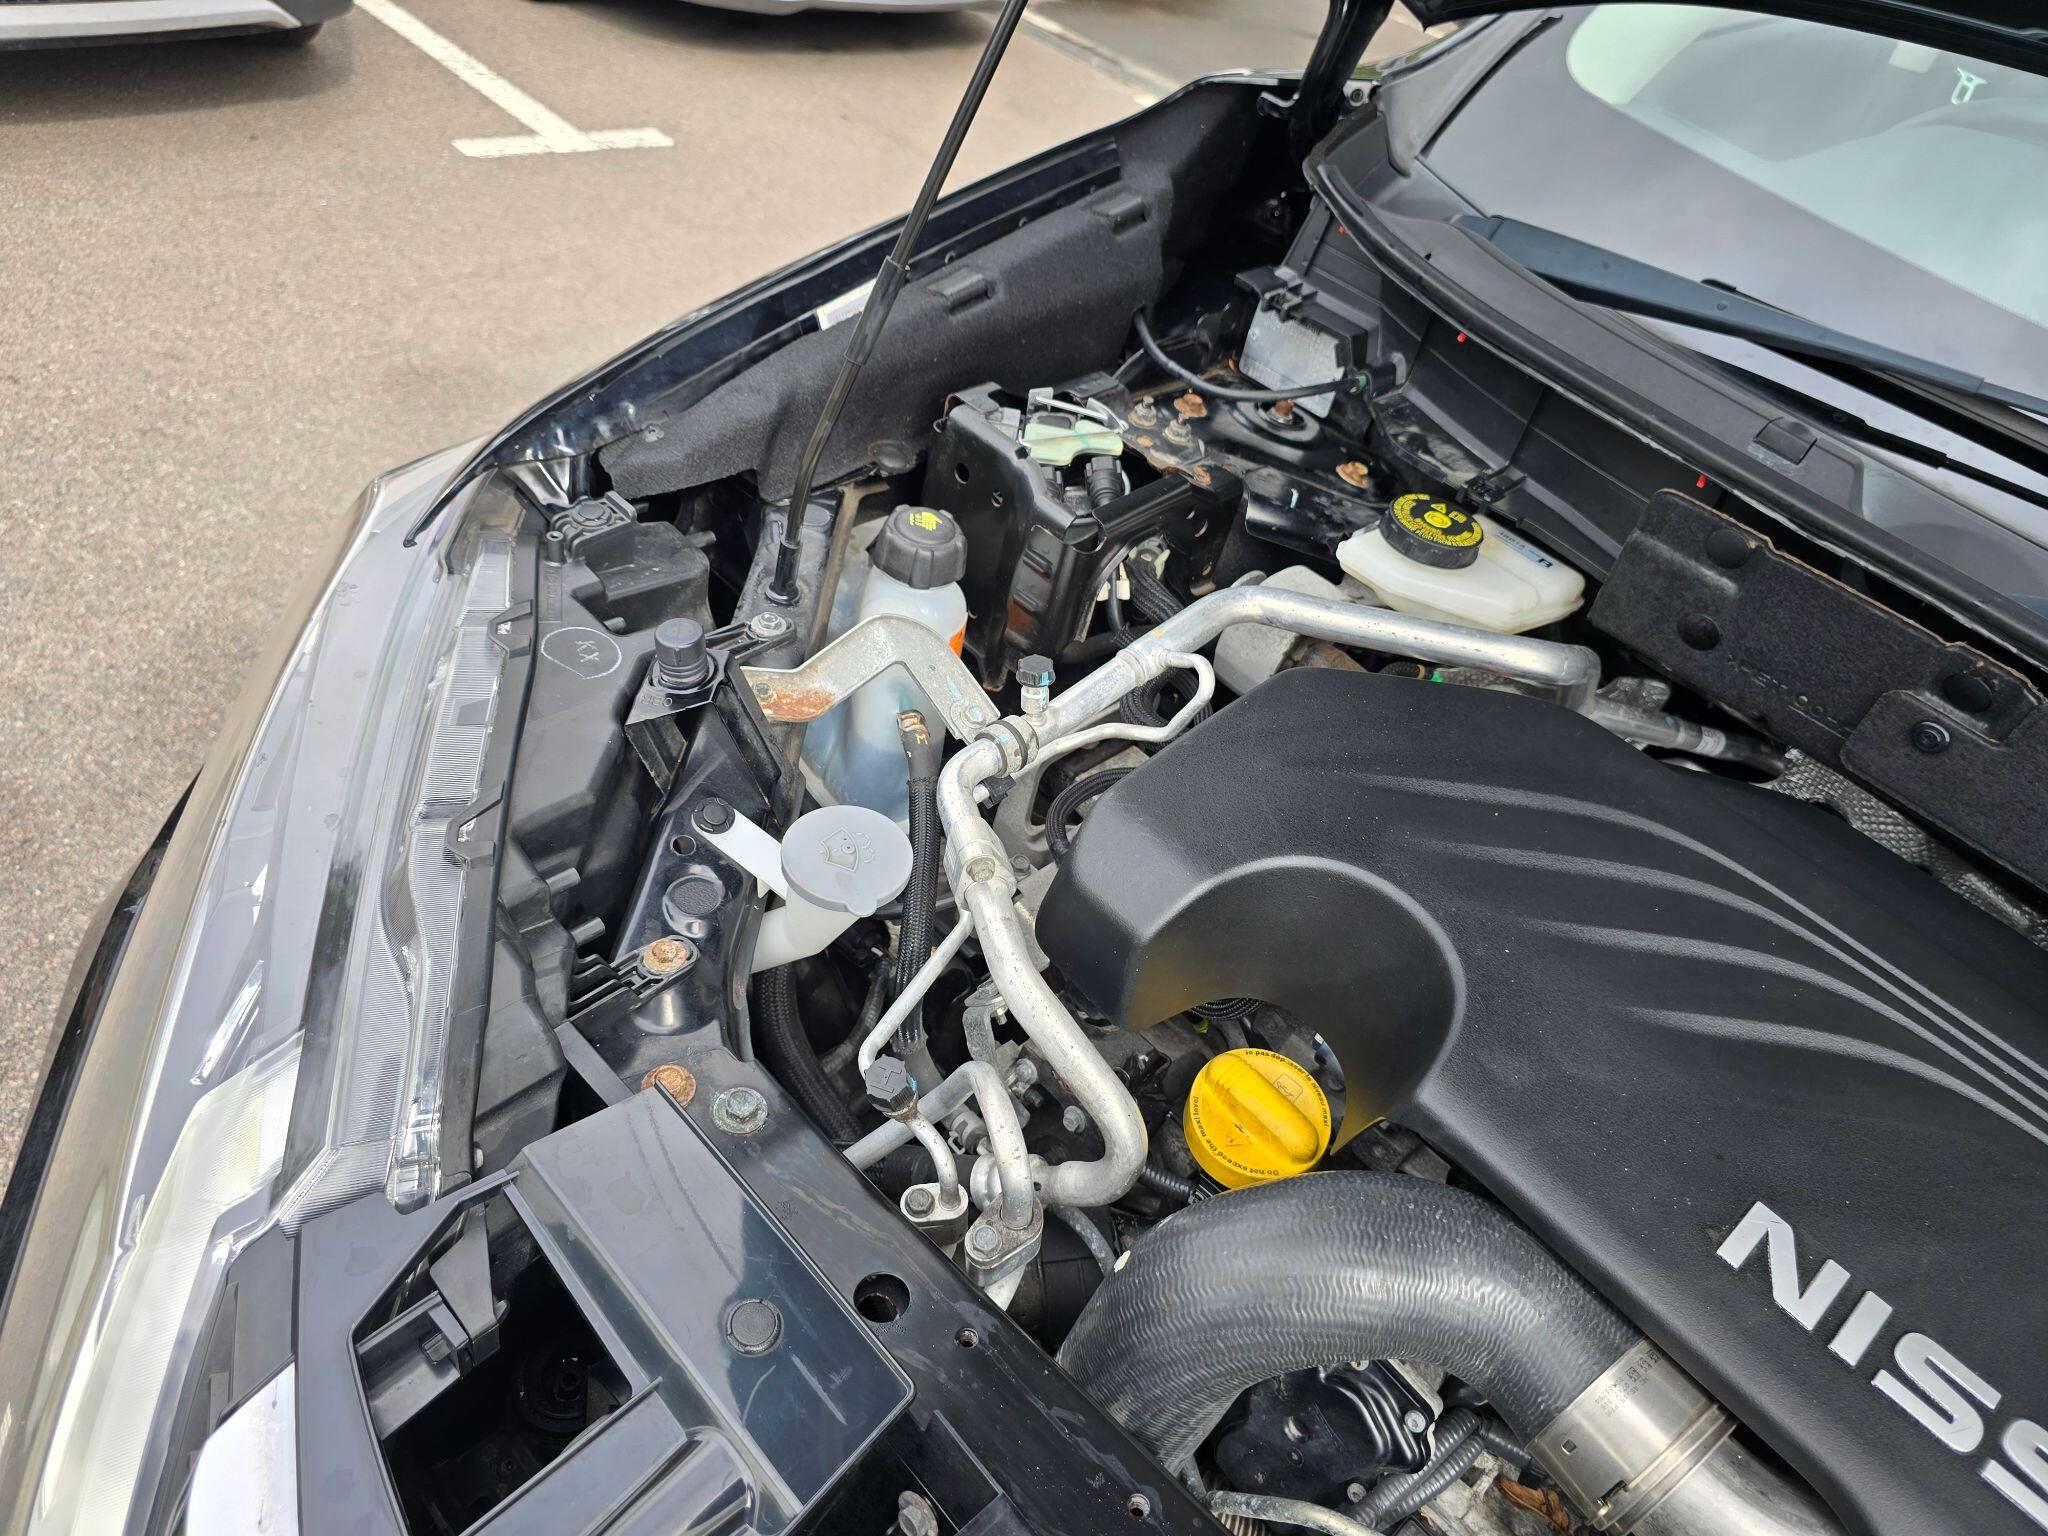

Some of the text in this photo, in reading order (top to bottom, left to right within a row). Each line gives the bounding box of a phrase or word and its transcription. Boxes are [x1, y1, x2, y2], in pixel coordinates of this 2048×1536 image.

[1311, 1082, 1326, 1106] niveau
[1192, 1095, 1200, 1116] level
[1193, 1116, 1207, 1138] maxi
[1205, 1138, 1218, 1152] the
[1217, 1150, 1248, 1171] exceed
